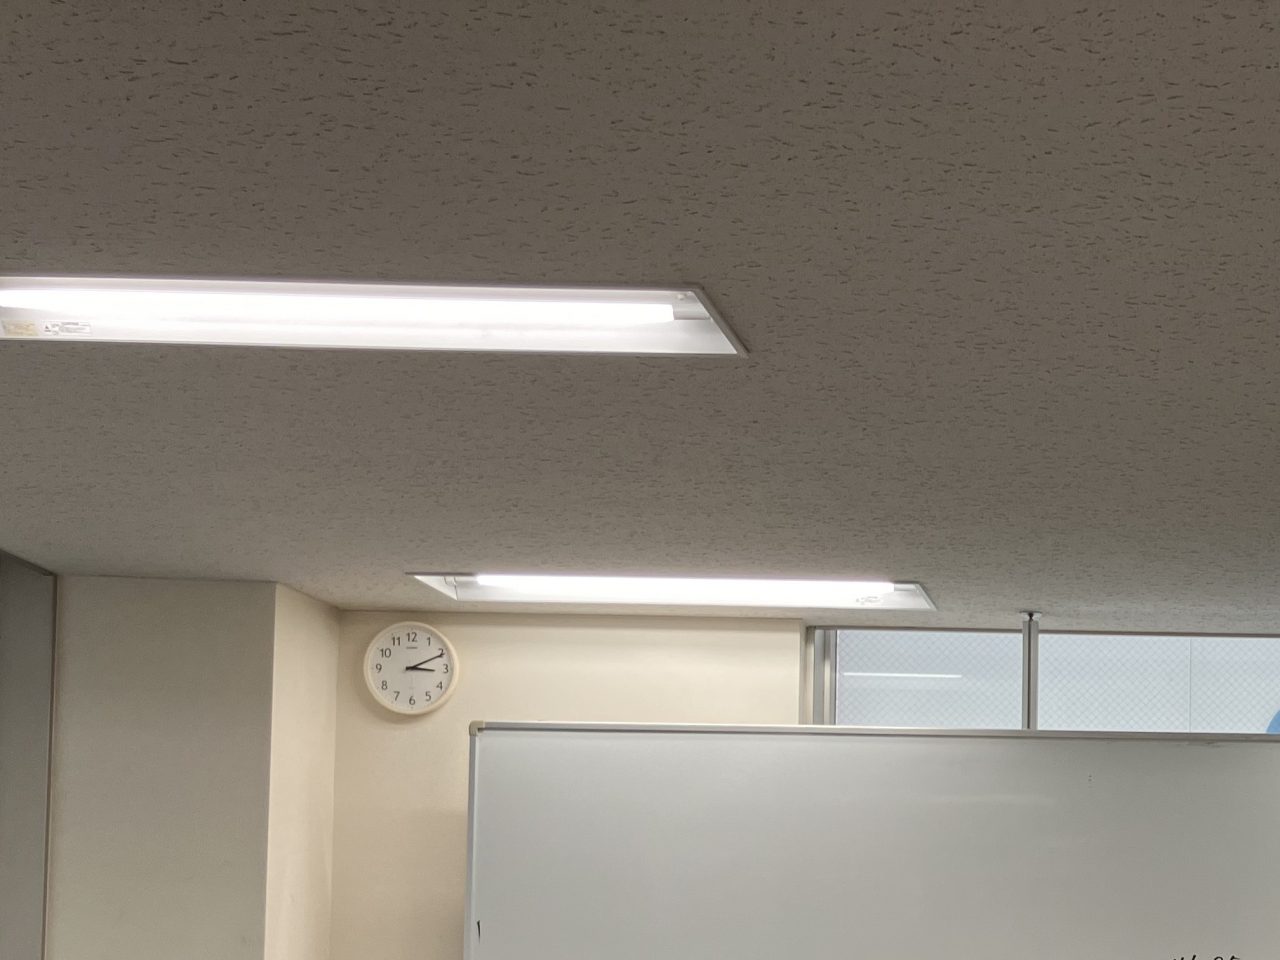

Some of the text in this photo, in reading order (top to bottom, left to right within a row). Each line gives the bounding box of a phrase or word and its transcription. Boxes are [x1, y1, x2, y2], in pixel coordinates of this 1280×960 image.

[392, 637, 401, 646] 11
[406, 632, 418, 642] 12
[427, 637, 431, 646] 1
[380, 648, 391, 658] 10
[376, 664, 382, 673] 9
[443, 664, 449, 673] 3
[382, 681, 388, 690] 8
[436, 681, 443, 690] 4
[394, 691, 400, 701] 7
[409, 696, 416, 705] 6
[425, 691, 431, 701] 5
